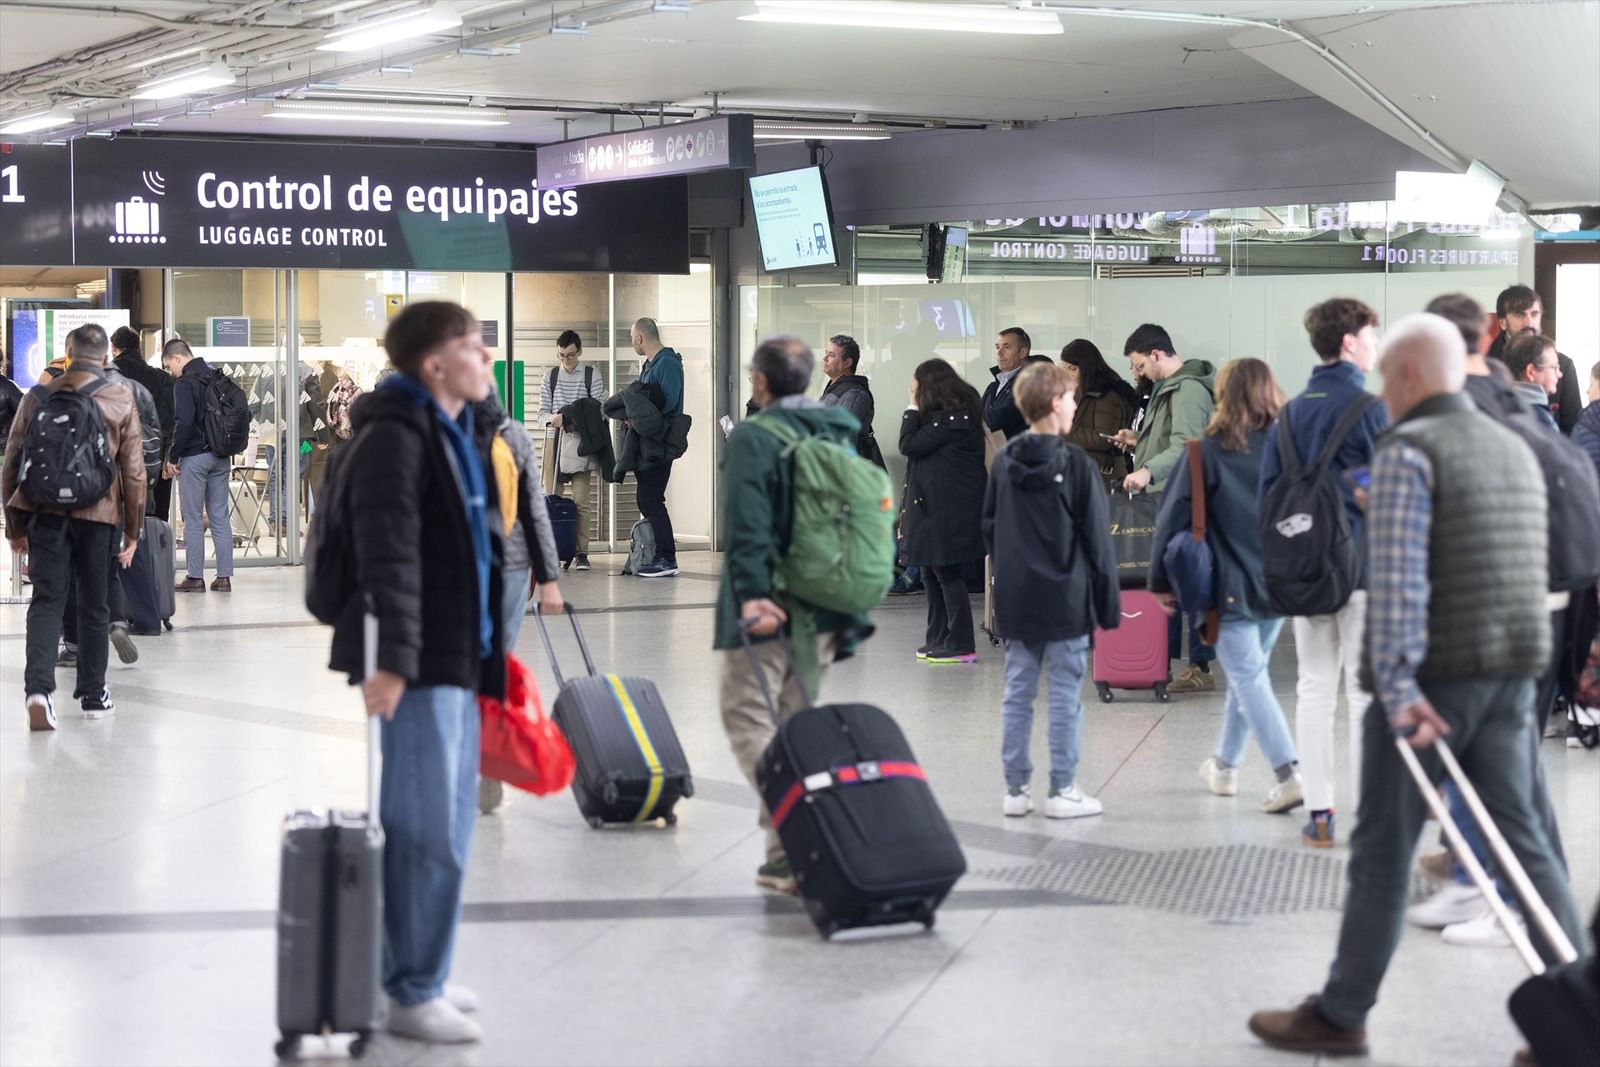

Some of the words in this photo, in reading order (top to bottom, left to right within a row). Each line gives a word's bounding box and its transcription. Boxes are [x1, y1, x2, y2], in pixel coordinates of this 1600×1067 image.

[2, 165, 26, 203] 1
[197, 172, 332, 210] Control
[347, 176, 393, 212] de
[406, 177, 579, 224] equipajes
[199, 226, 292, 245] LUGGAGE
[301, 228, 387, 247] CONTROL
